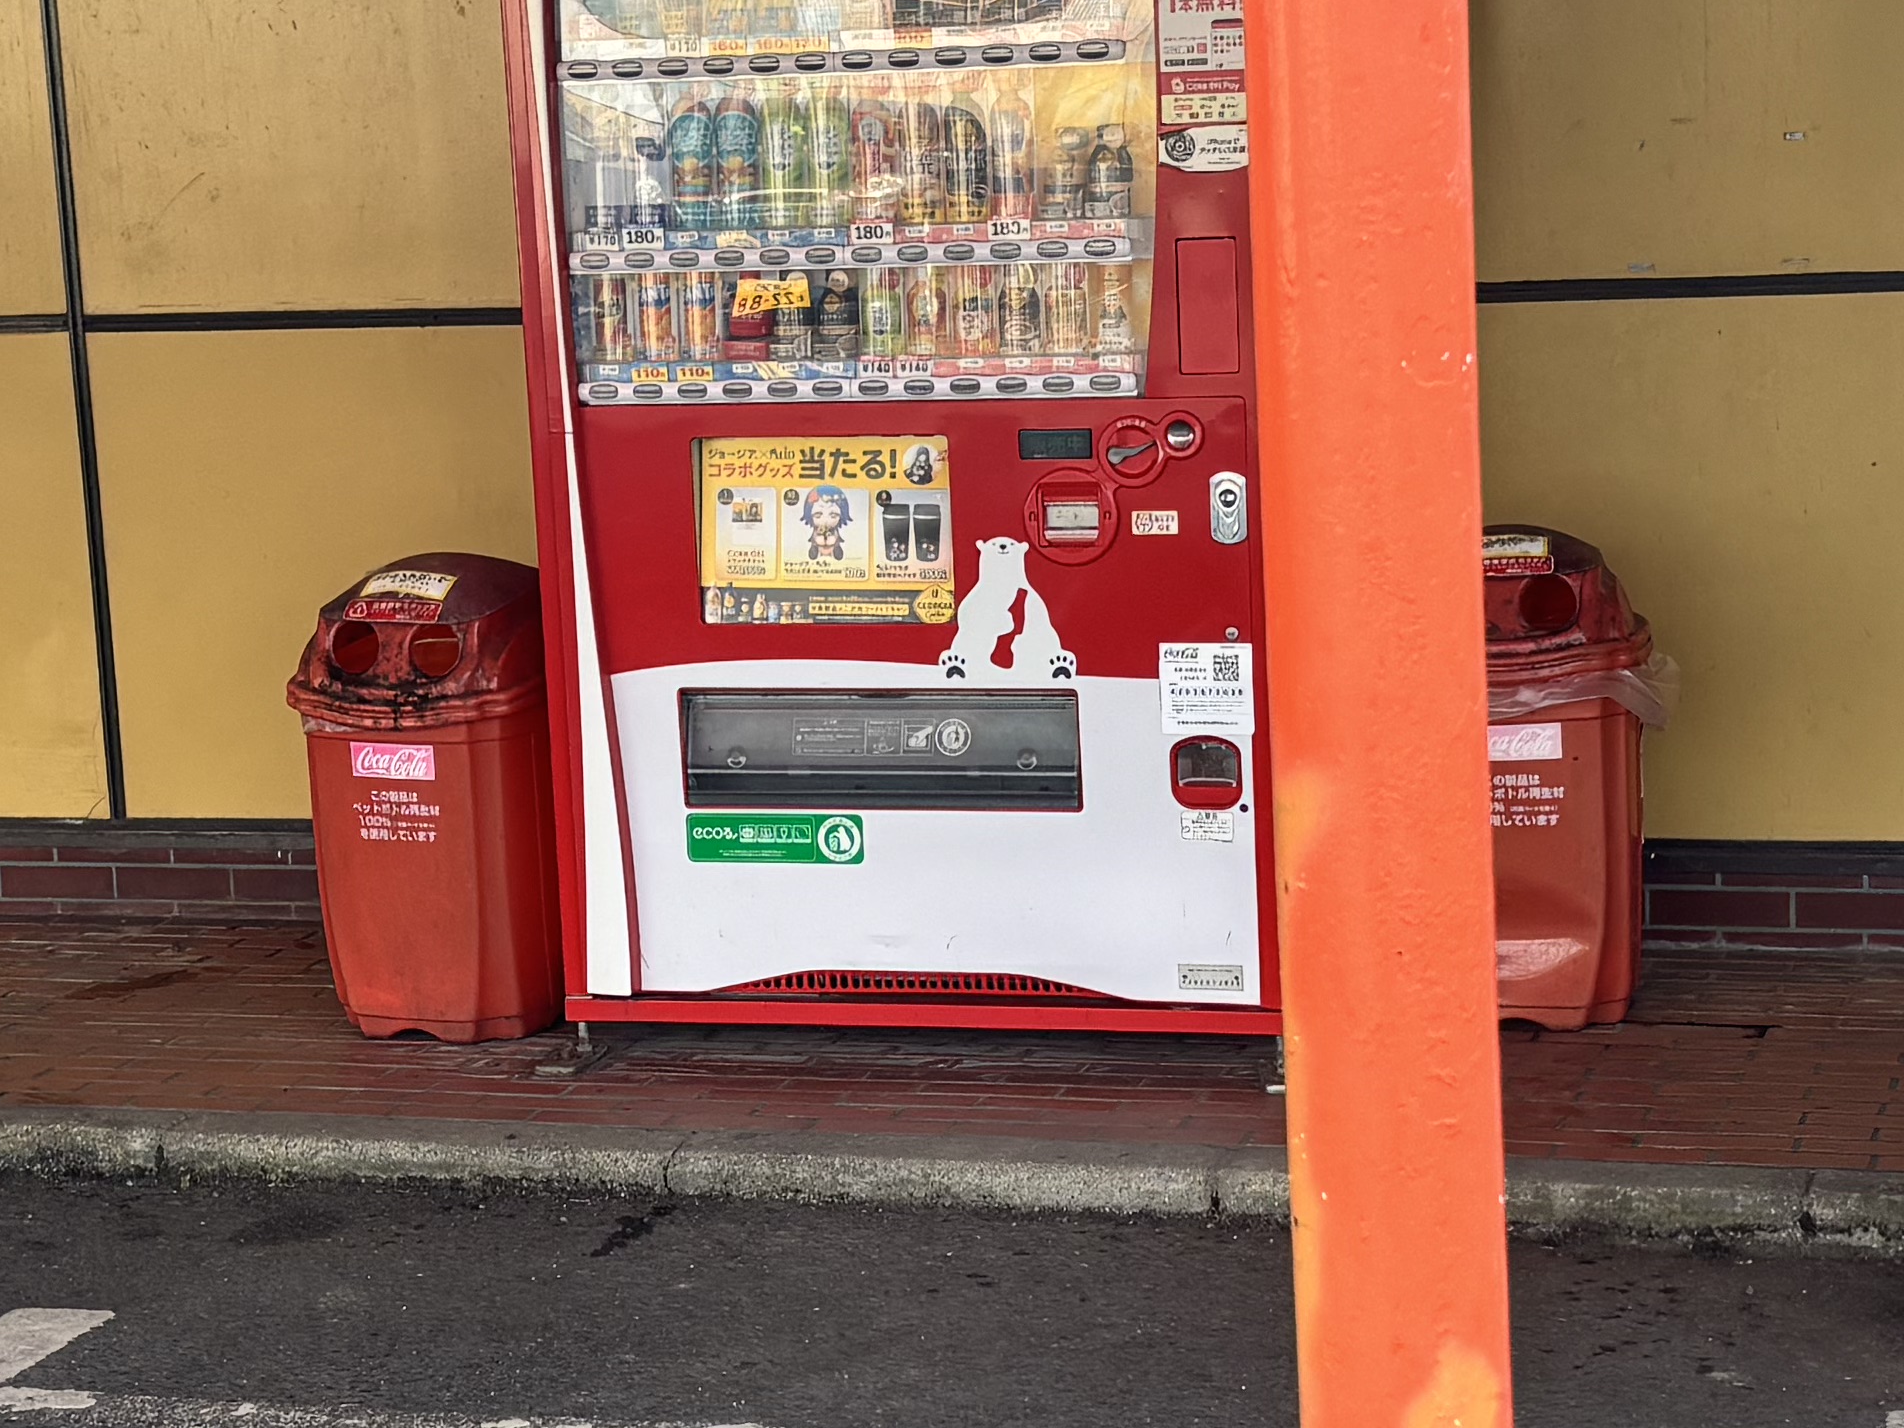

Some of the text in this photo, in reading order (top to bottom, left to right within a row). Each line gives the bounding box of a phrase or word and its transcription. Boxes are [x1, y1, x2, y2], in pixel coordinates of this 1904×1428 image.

[708, 445, 898, 480] コラボグッズ 当たる!
[356, 746, 431, 777] Coca-Cola
